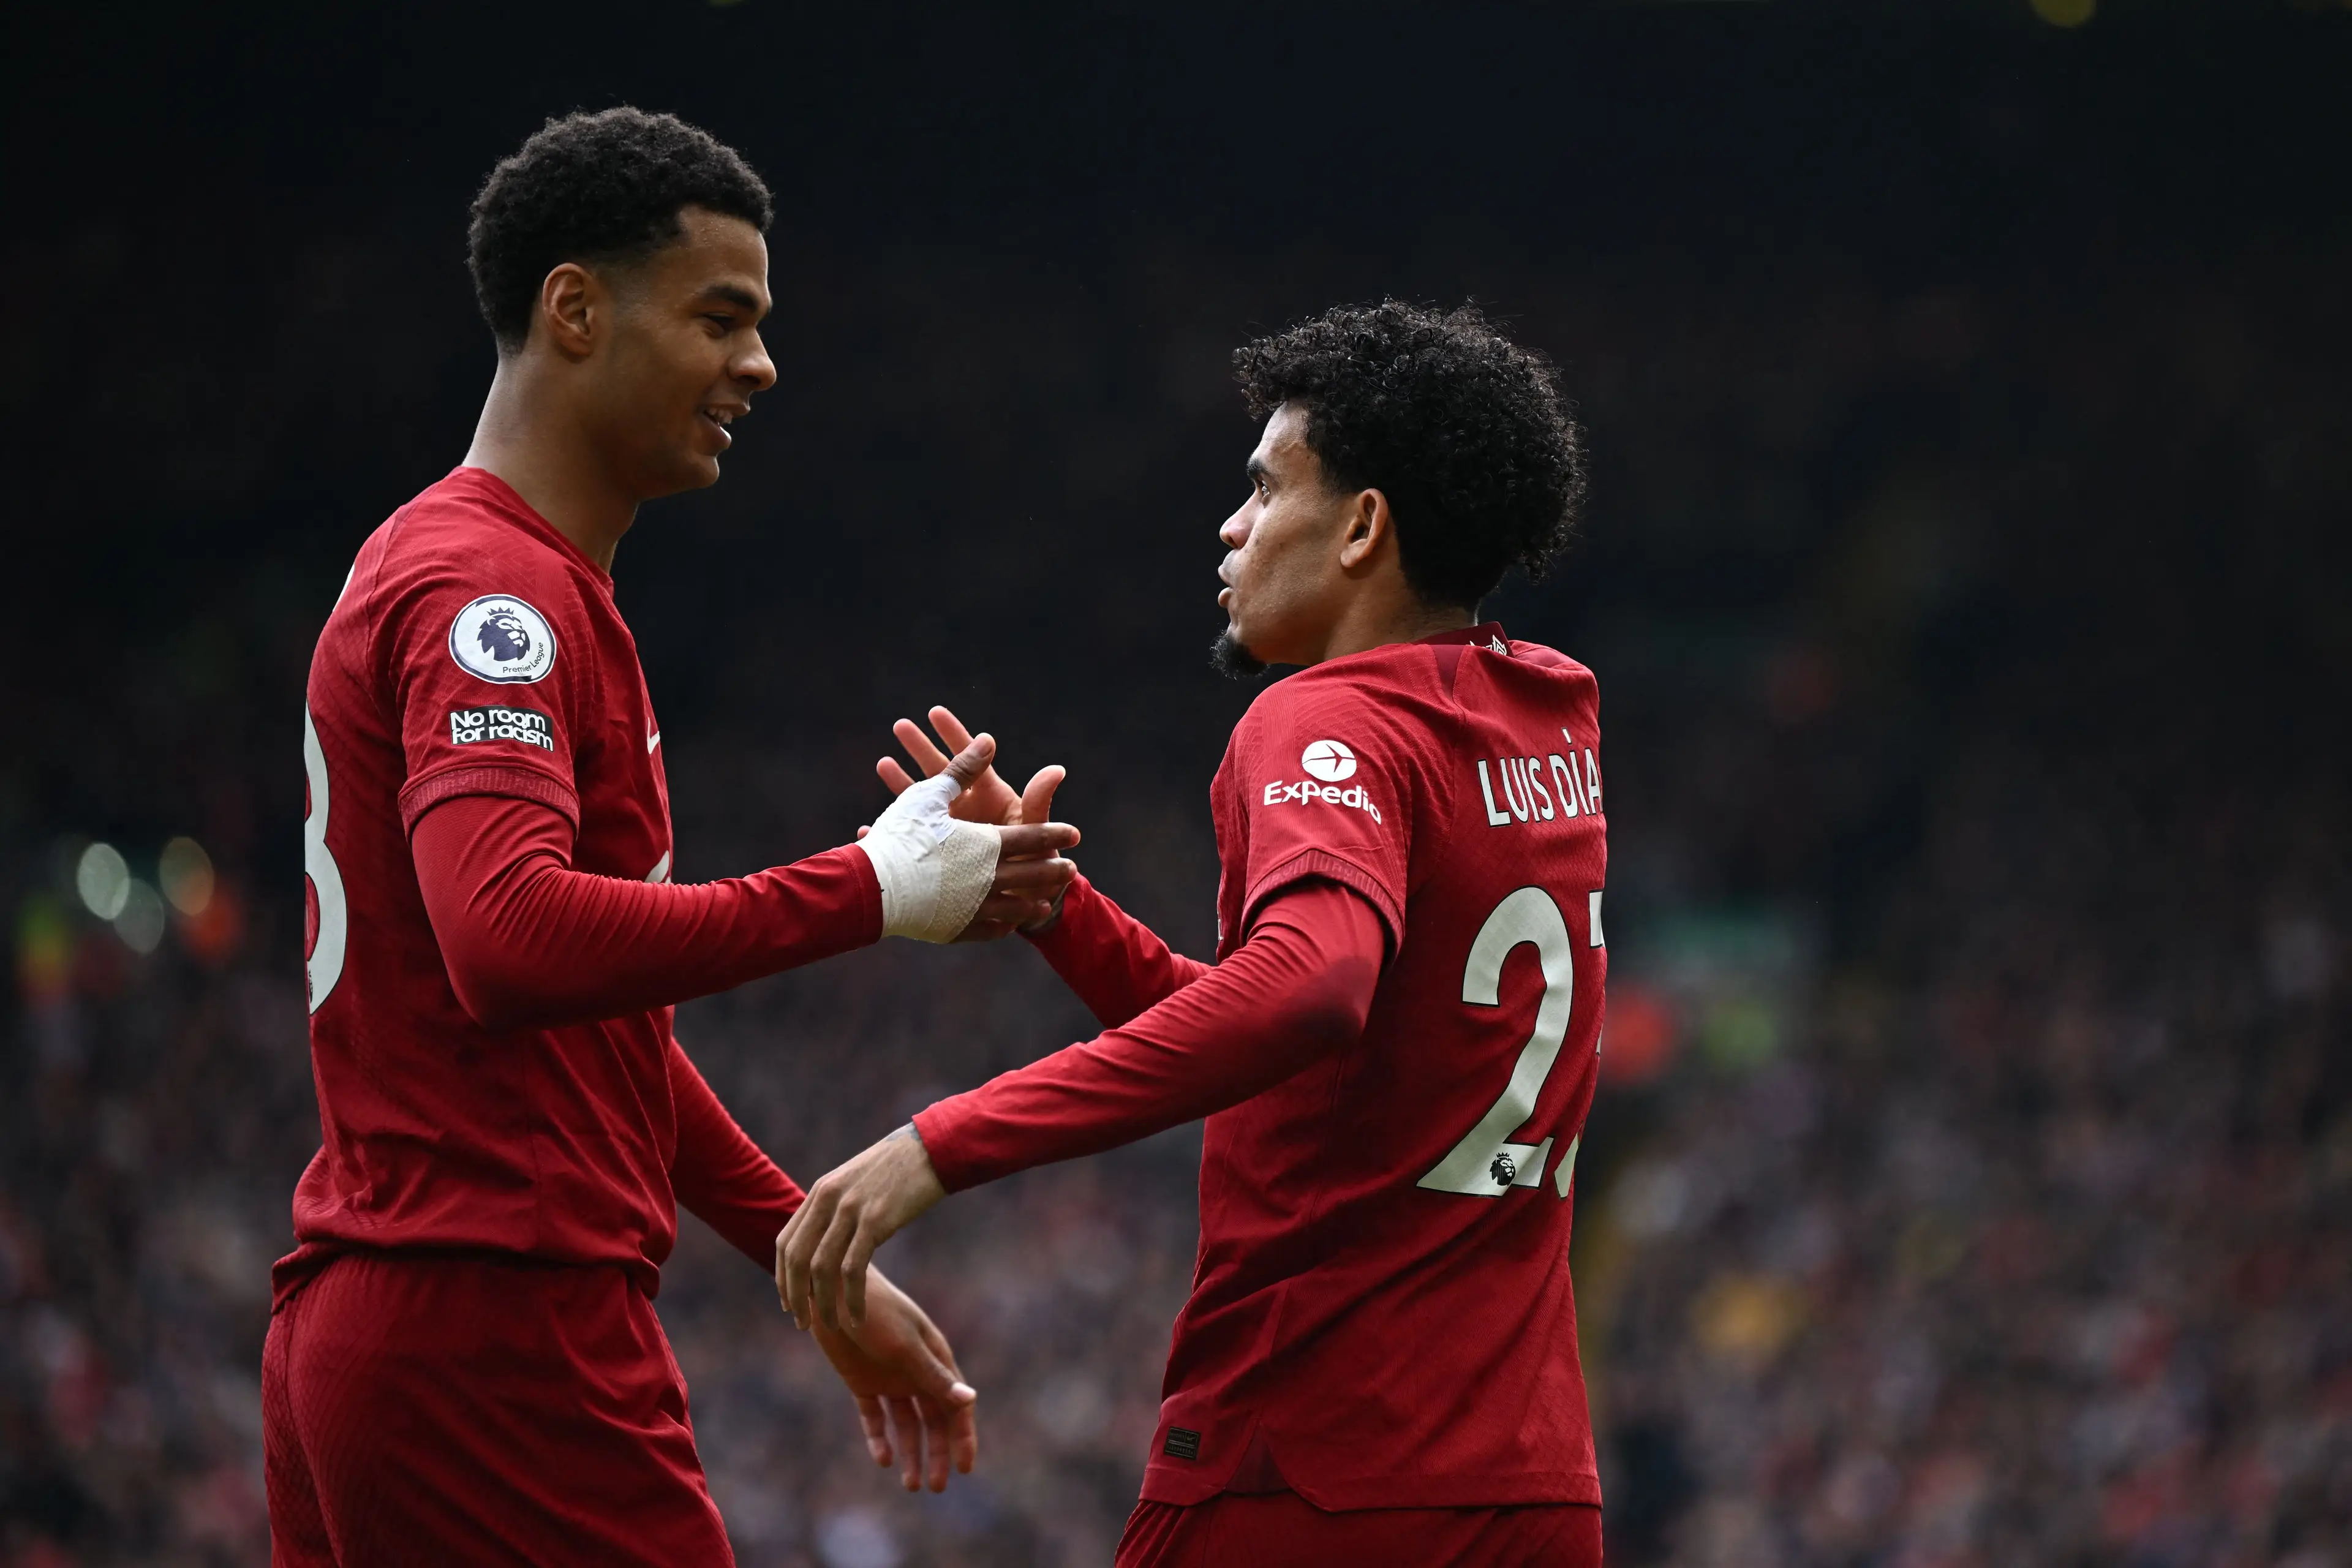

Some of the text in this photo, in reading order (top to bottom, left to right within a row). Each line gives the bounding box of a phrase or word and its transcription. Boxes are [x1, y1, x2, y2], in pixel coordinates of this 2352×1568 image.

[503, 642, 545, 673] Premier League
[450, 709, 546, 732] No room
[451, 725, 554, 752] for racism
[1264, 780, 1381, 824] Expedia
[1477, 756, 1555, 827] LUIS
[1416, 884, 1605, 1200] 2
